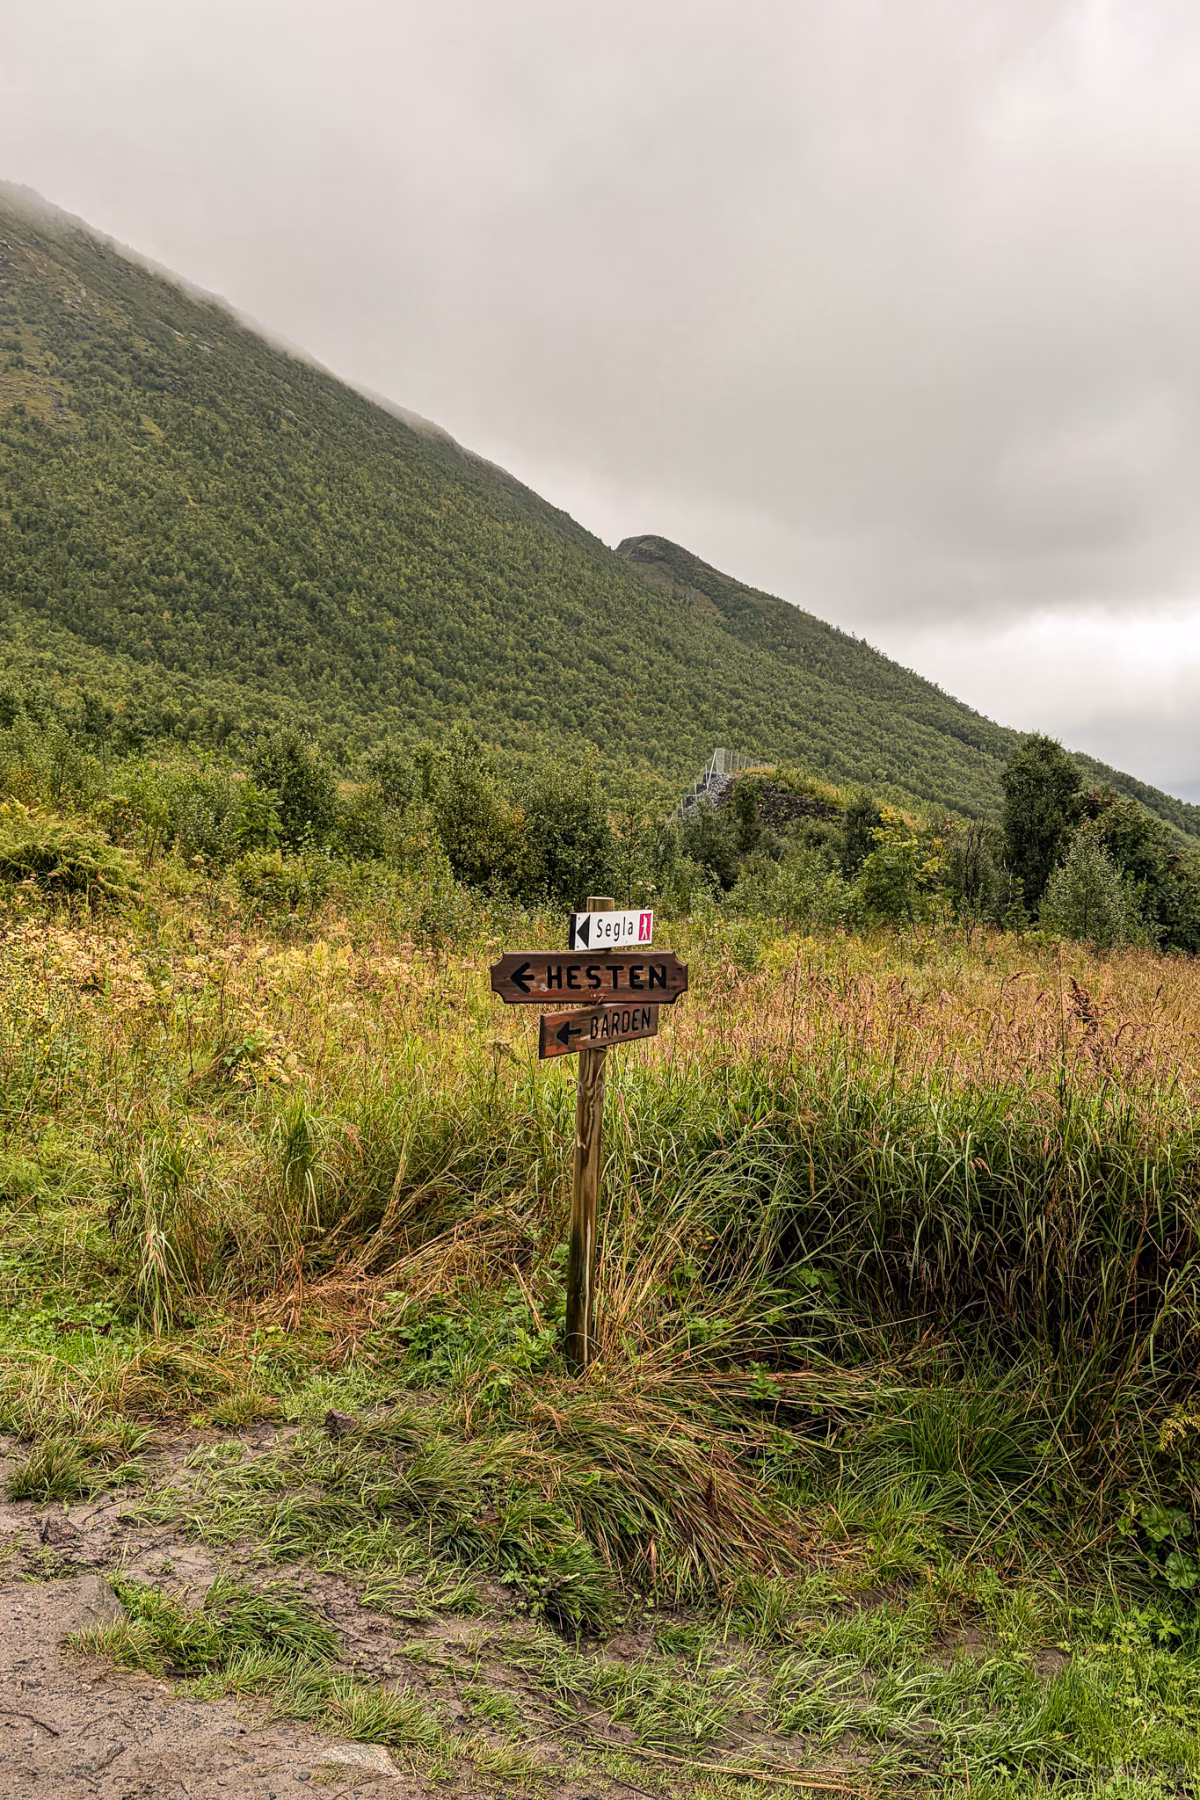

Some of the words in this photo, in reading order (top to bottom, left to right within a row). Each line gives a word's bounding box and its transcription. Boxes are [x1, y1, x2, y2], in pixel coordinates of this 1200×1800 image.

[596, 916, 634, 942] Segla
[547, 965, 667, 990] HESTEN
[590, 1006, 651, 1040] BARDEN
